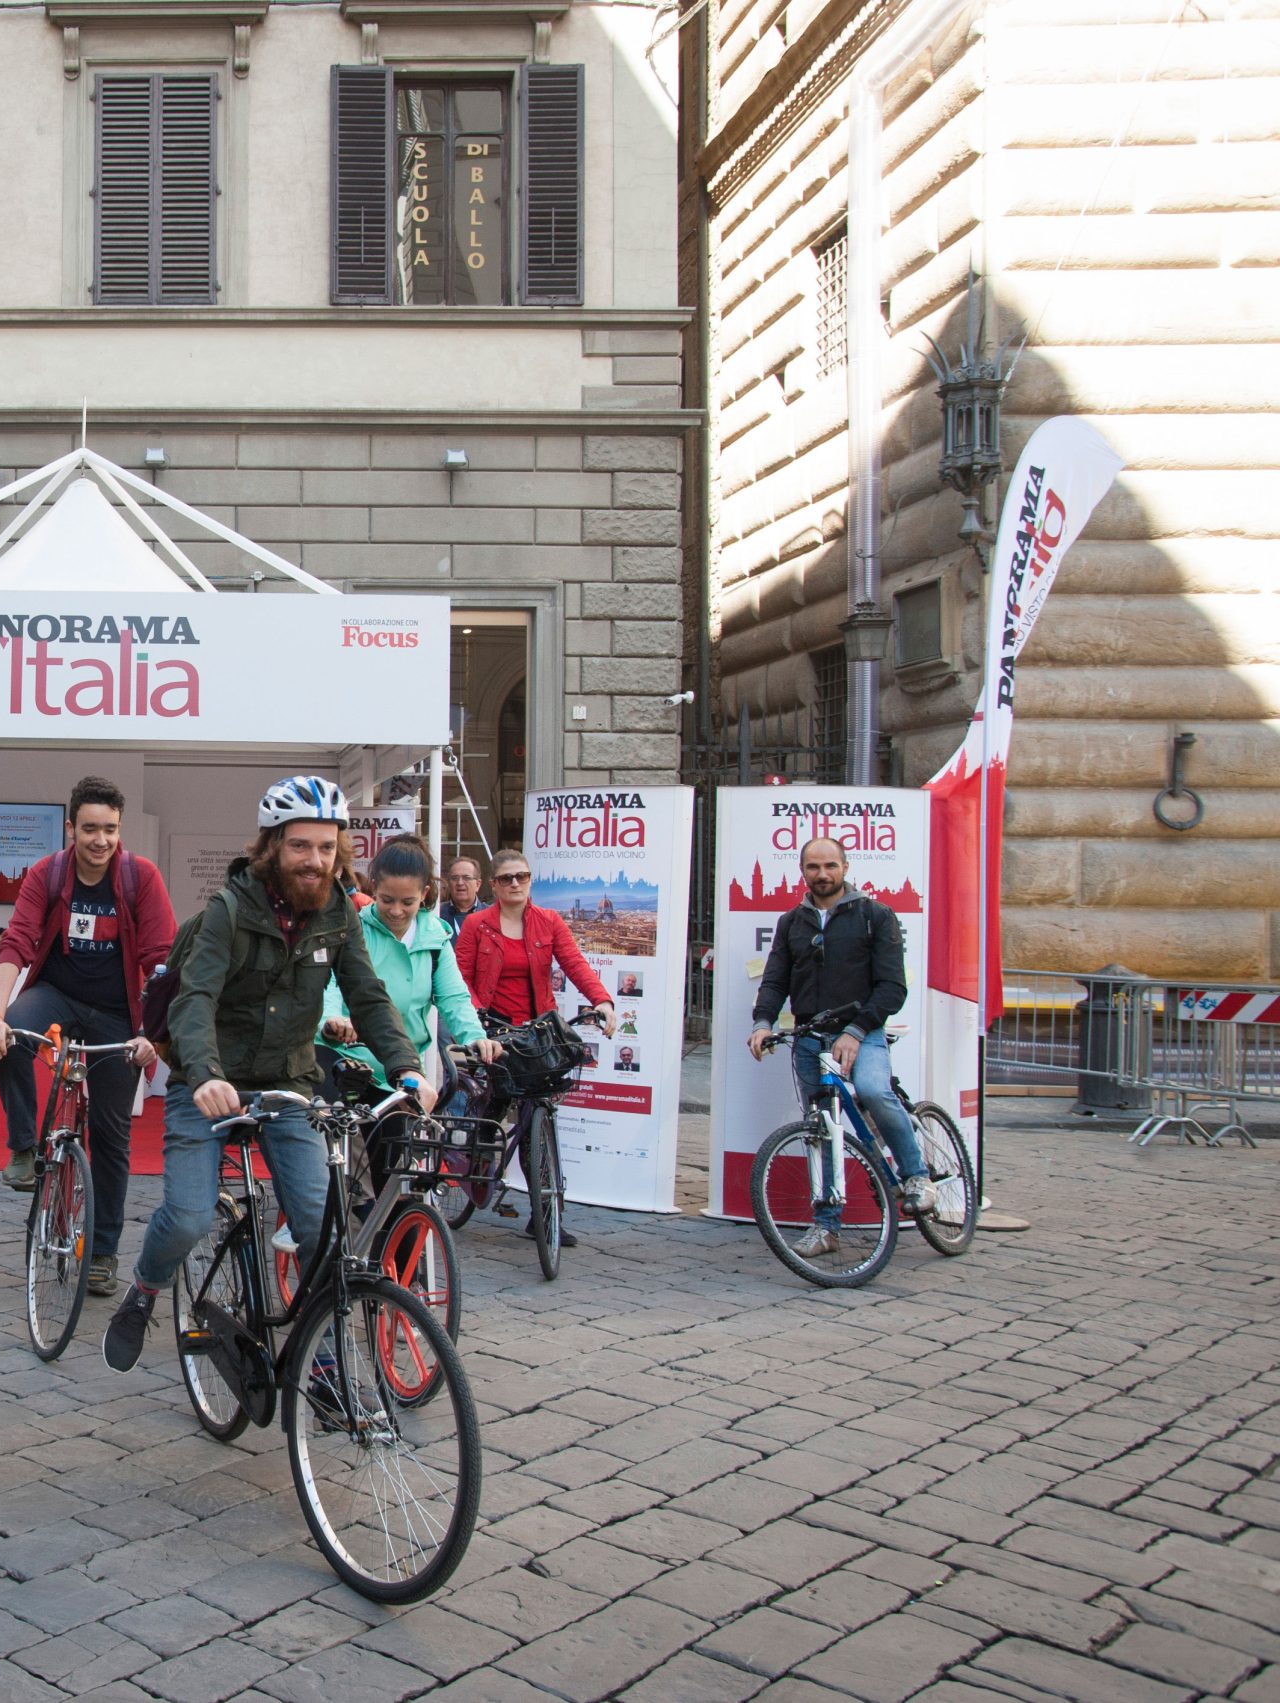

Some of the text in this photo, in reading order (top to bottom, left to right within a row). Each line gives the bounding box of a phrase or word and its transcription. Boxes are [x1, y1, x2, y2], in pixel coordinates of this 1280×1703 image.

[467, 143, 489, 156] DI
[412, 142, 430, 266] SCUOLA
[467, 166, 486, 269] BALLO
[997, 464, 1046, 715] PANORAMA
[348, 618, 404, 626] COLLABORAZIONE
[341, 625, 419, 648] Focus
[536, 793, 646, 812] PANORAMA
[772, 802, 896, 818] PANORAMA
[348, 817, 402, 830] RAMA
[535, 800, 645, 849] d'Italia
[772, 809, 896, 851] d'Italia
[554, 850, 579, 859] MEGLIO
[579, 850, 602, 859] VISTO
[616, 851, 646, 859] VICINO
[71, 902, 117, 916] ENNA
[69, 938, 114, 951] STRIA
[596, 957, 613, 966] Aprile
